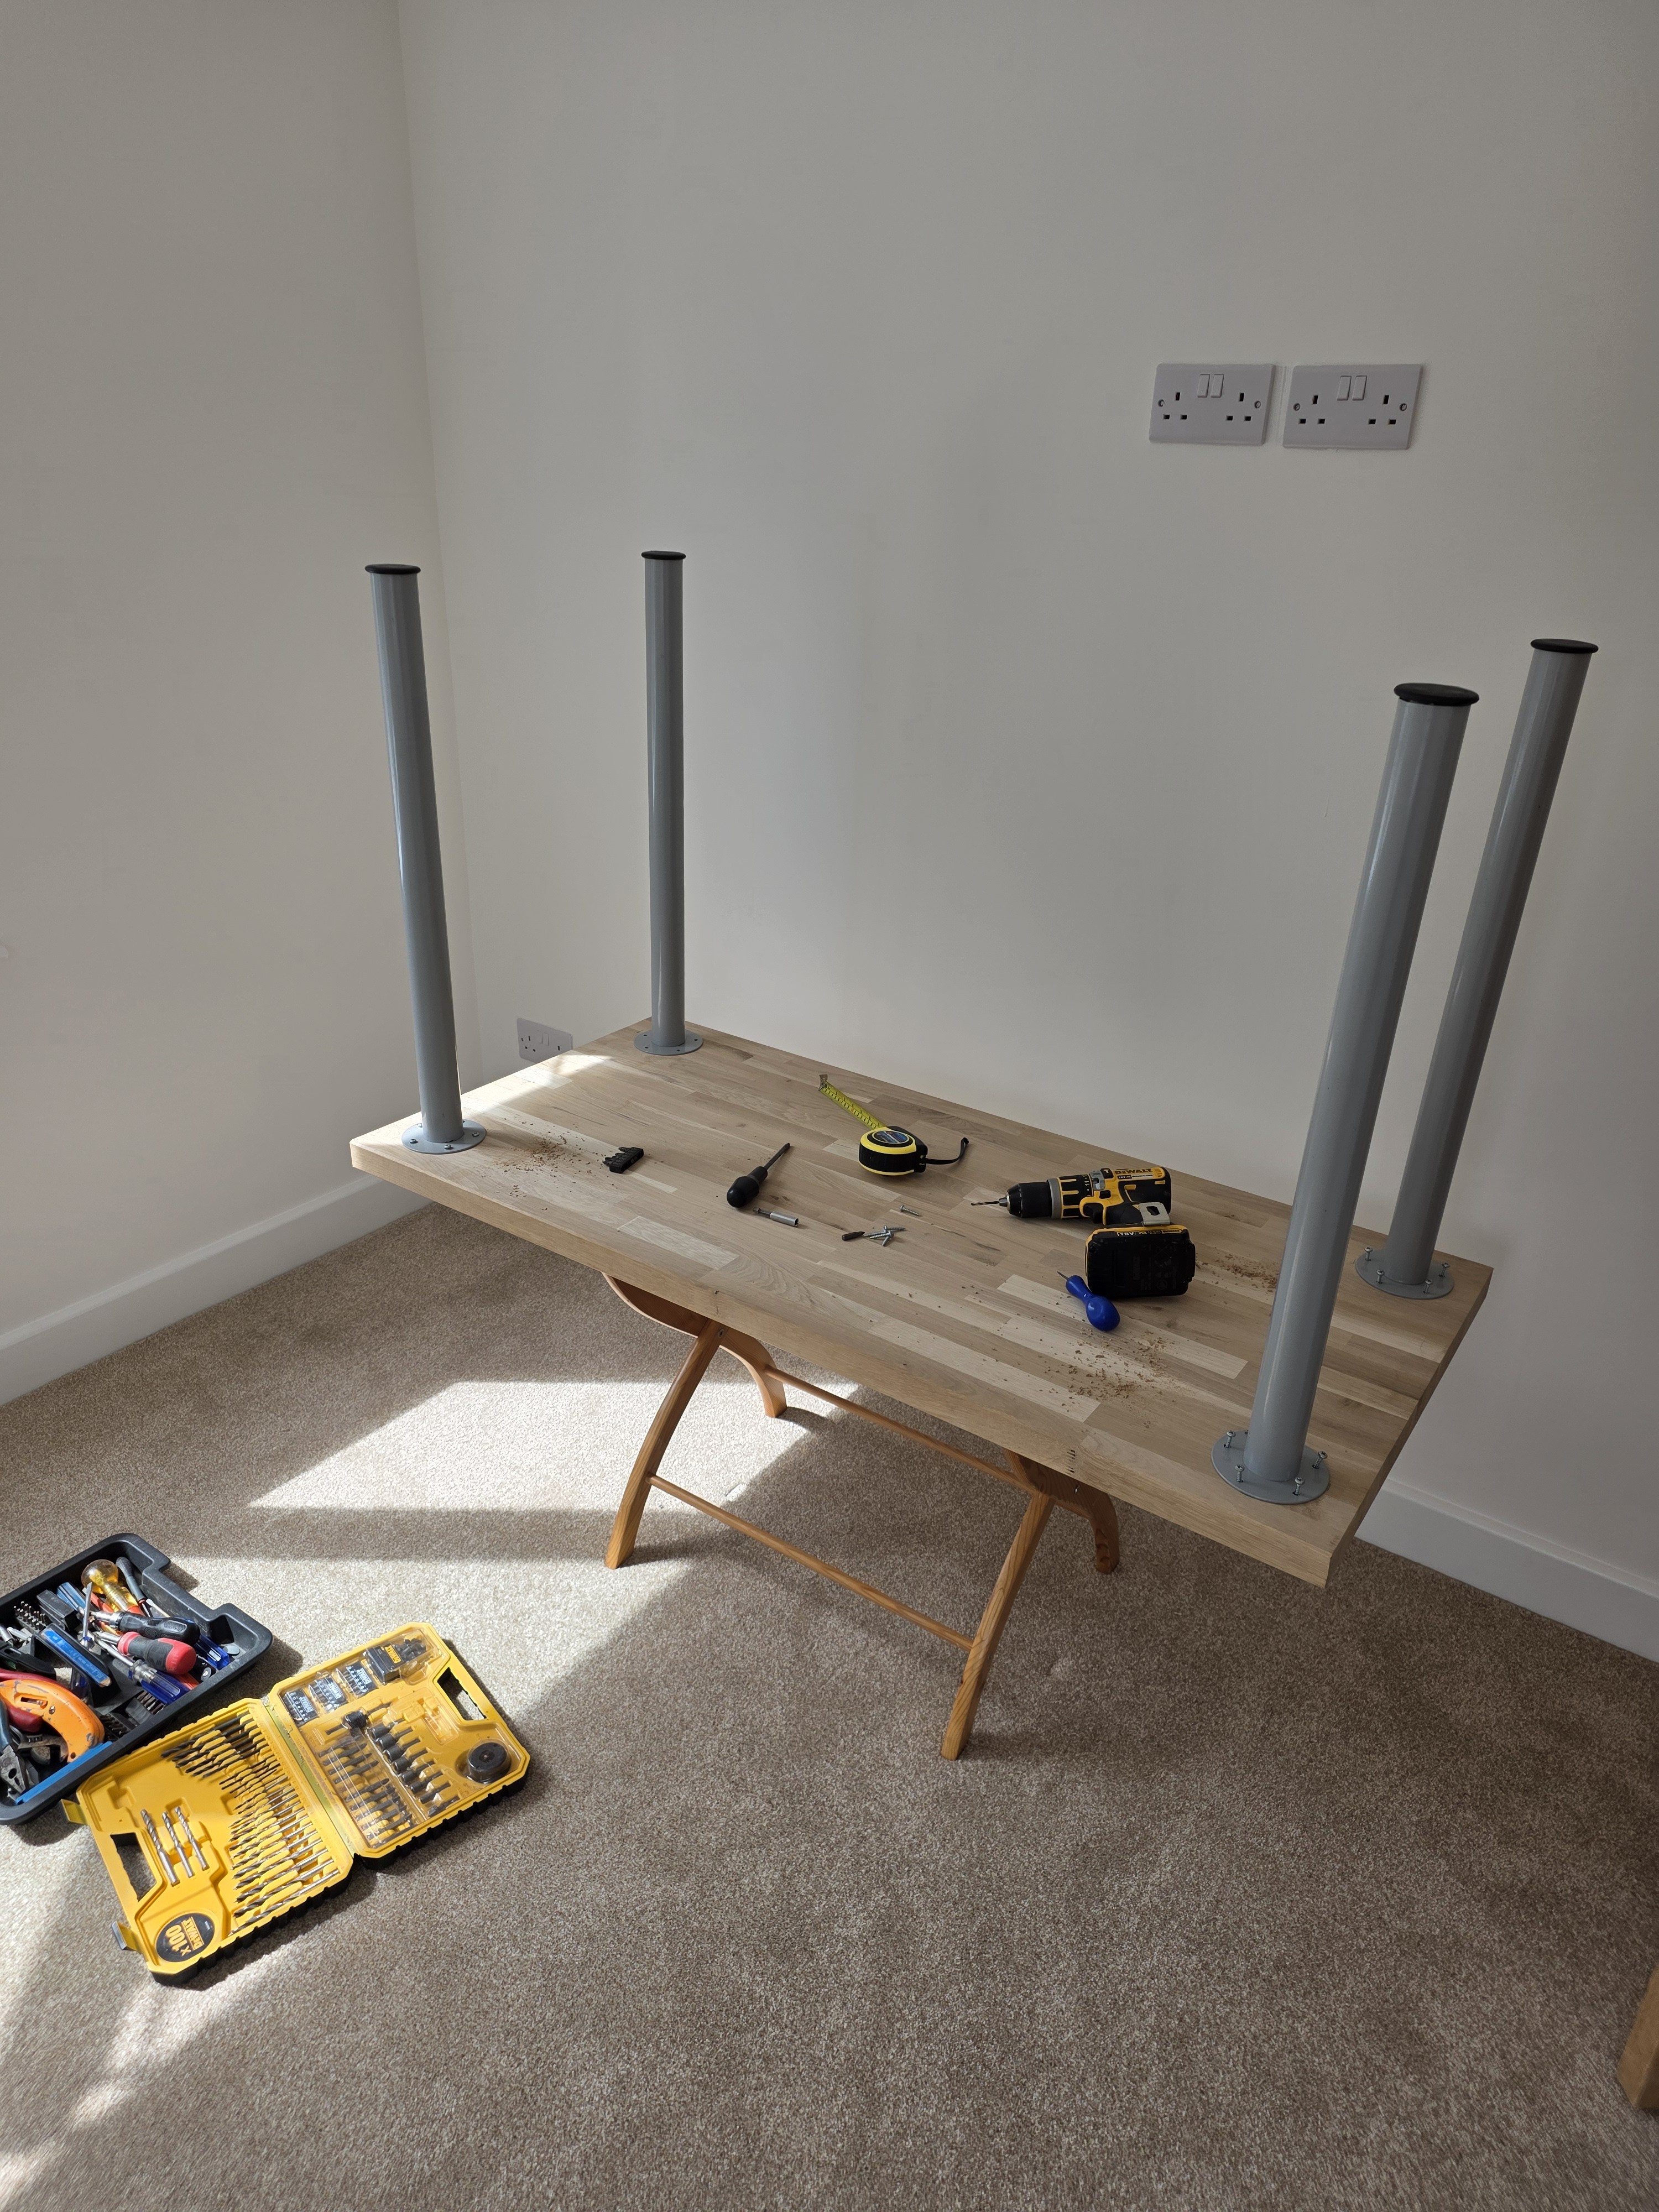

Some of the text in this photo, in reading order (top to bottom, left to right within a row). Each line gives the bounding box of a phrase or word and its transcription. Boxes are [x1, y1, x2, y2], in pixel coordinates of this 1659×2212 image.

[385, 1645, 401, 1663] DEWALT
[356, 1668, 372, 1684] DEWALT
[299, 1697, 314, 1713] DEWALT
[182, 1917, 204, 1950] DEWALT
